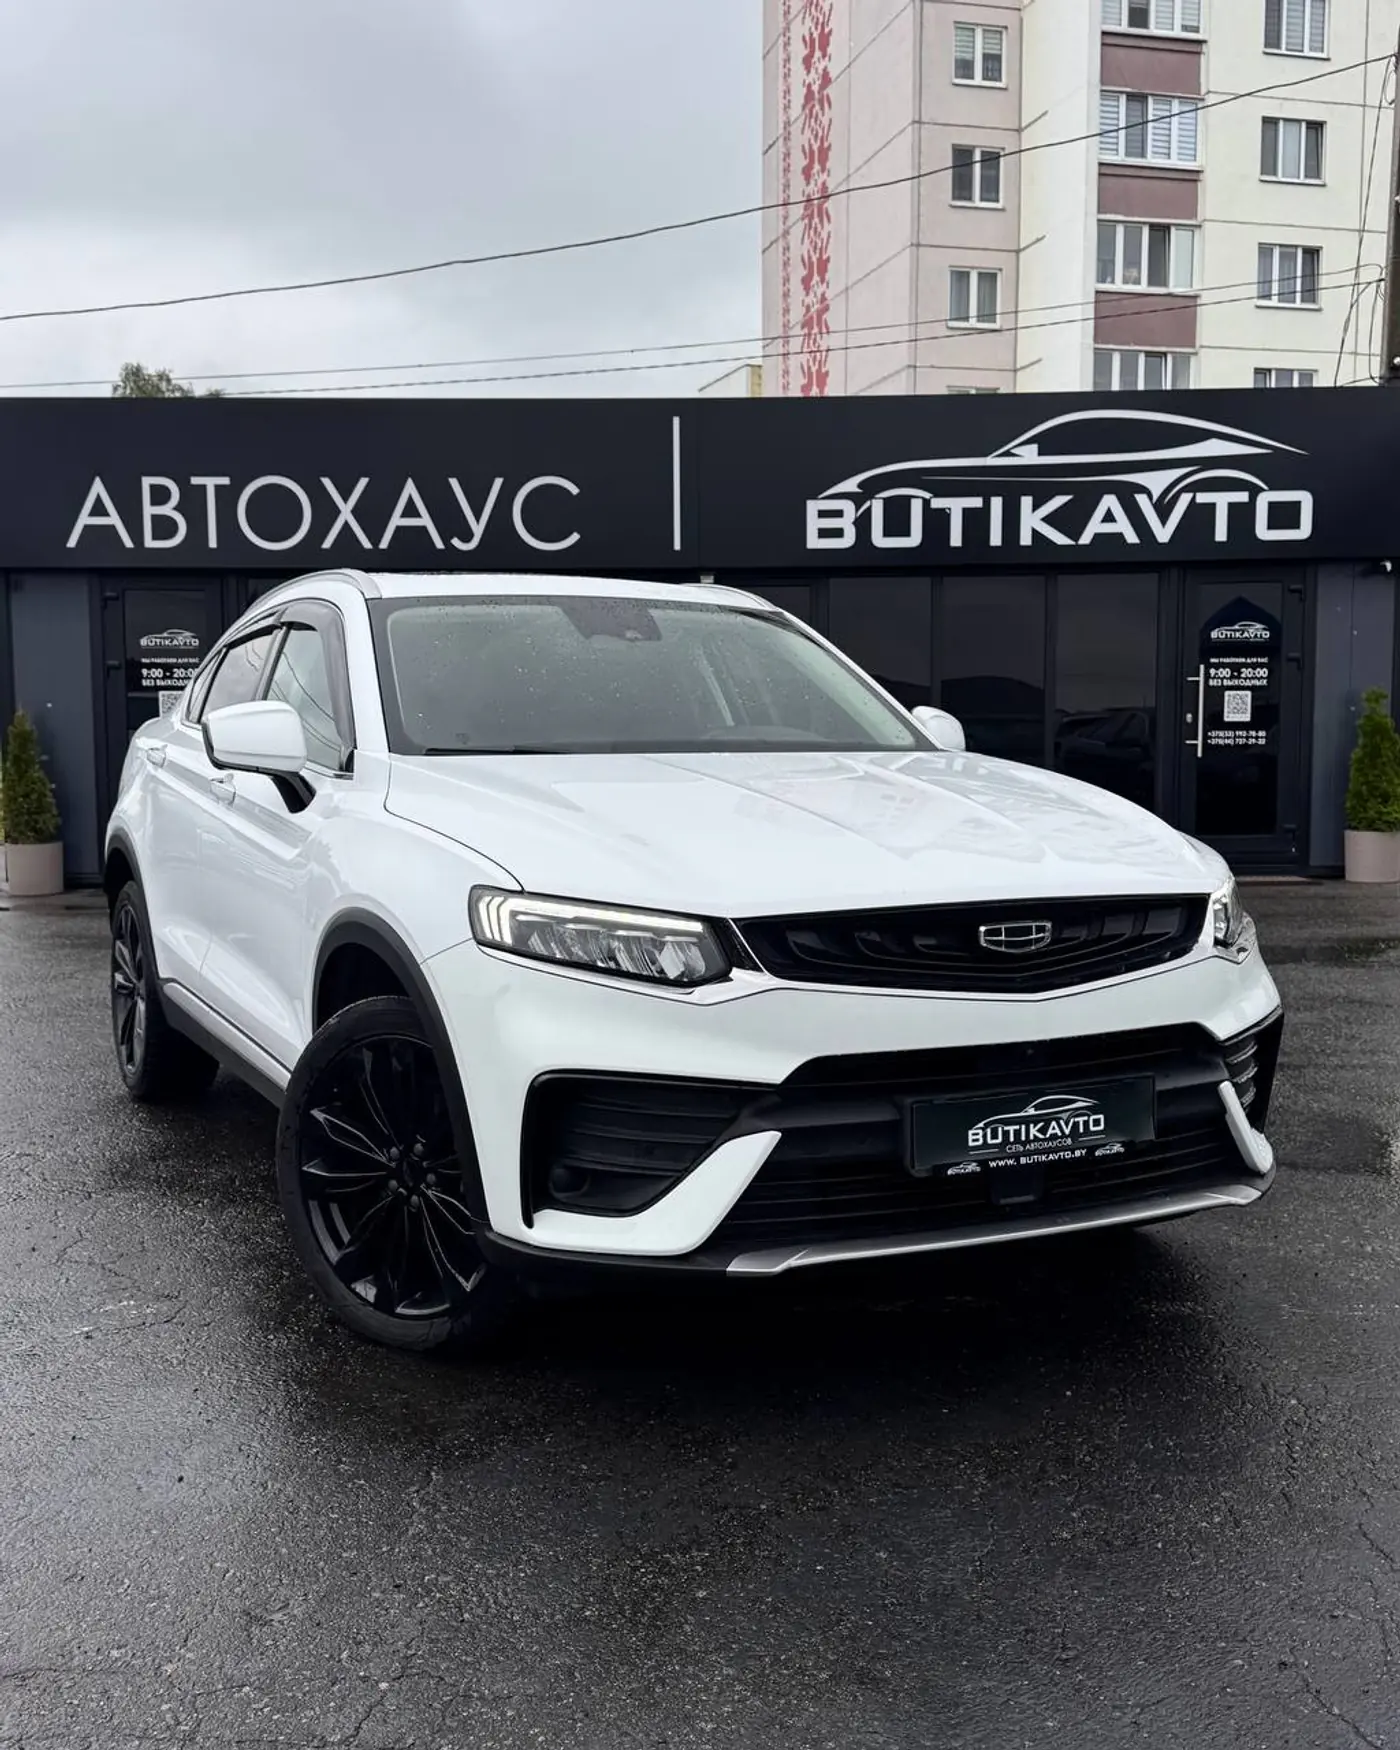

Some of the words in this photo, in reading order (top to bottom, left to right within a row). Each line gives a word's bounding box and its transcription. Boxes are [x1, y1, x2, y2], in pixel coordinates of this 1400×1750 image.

[66, 475, 581, 551] АВТОХАУС
[806, 490, 1313, 549] BUTIKAVTO
[1211, 630, 1270, 639] BUTIKAVTO
[141, 668, 163, 678] 9:00
[1209, 668, 1231, 678] 9:00
[1240, 668, 1269, 678] 20:00
[1208, 678, 1222, 687] БЕЗ
[1223, 678, 1268, 687] ВЫХОДНЫХ
[967, 1114, 1105, 1147] BUTIKAVTO
[1006, 1144, 1024, 1153] СЕТЬ
[1025, 1137, 1072, 1151] АВТОХАУСОВ
[1019, 1148, 1087, 1165] BUTIKAVTO.BY
